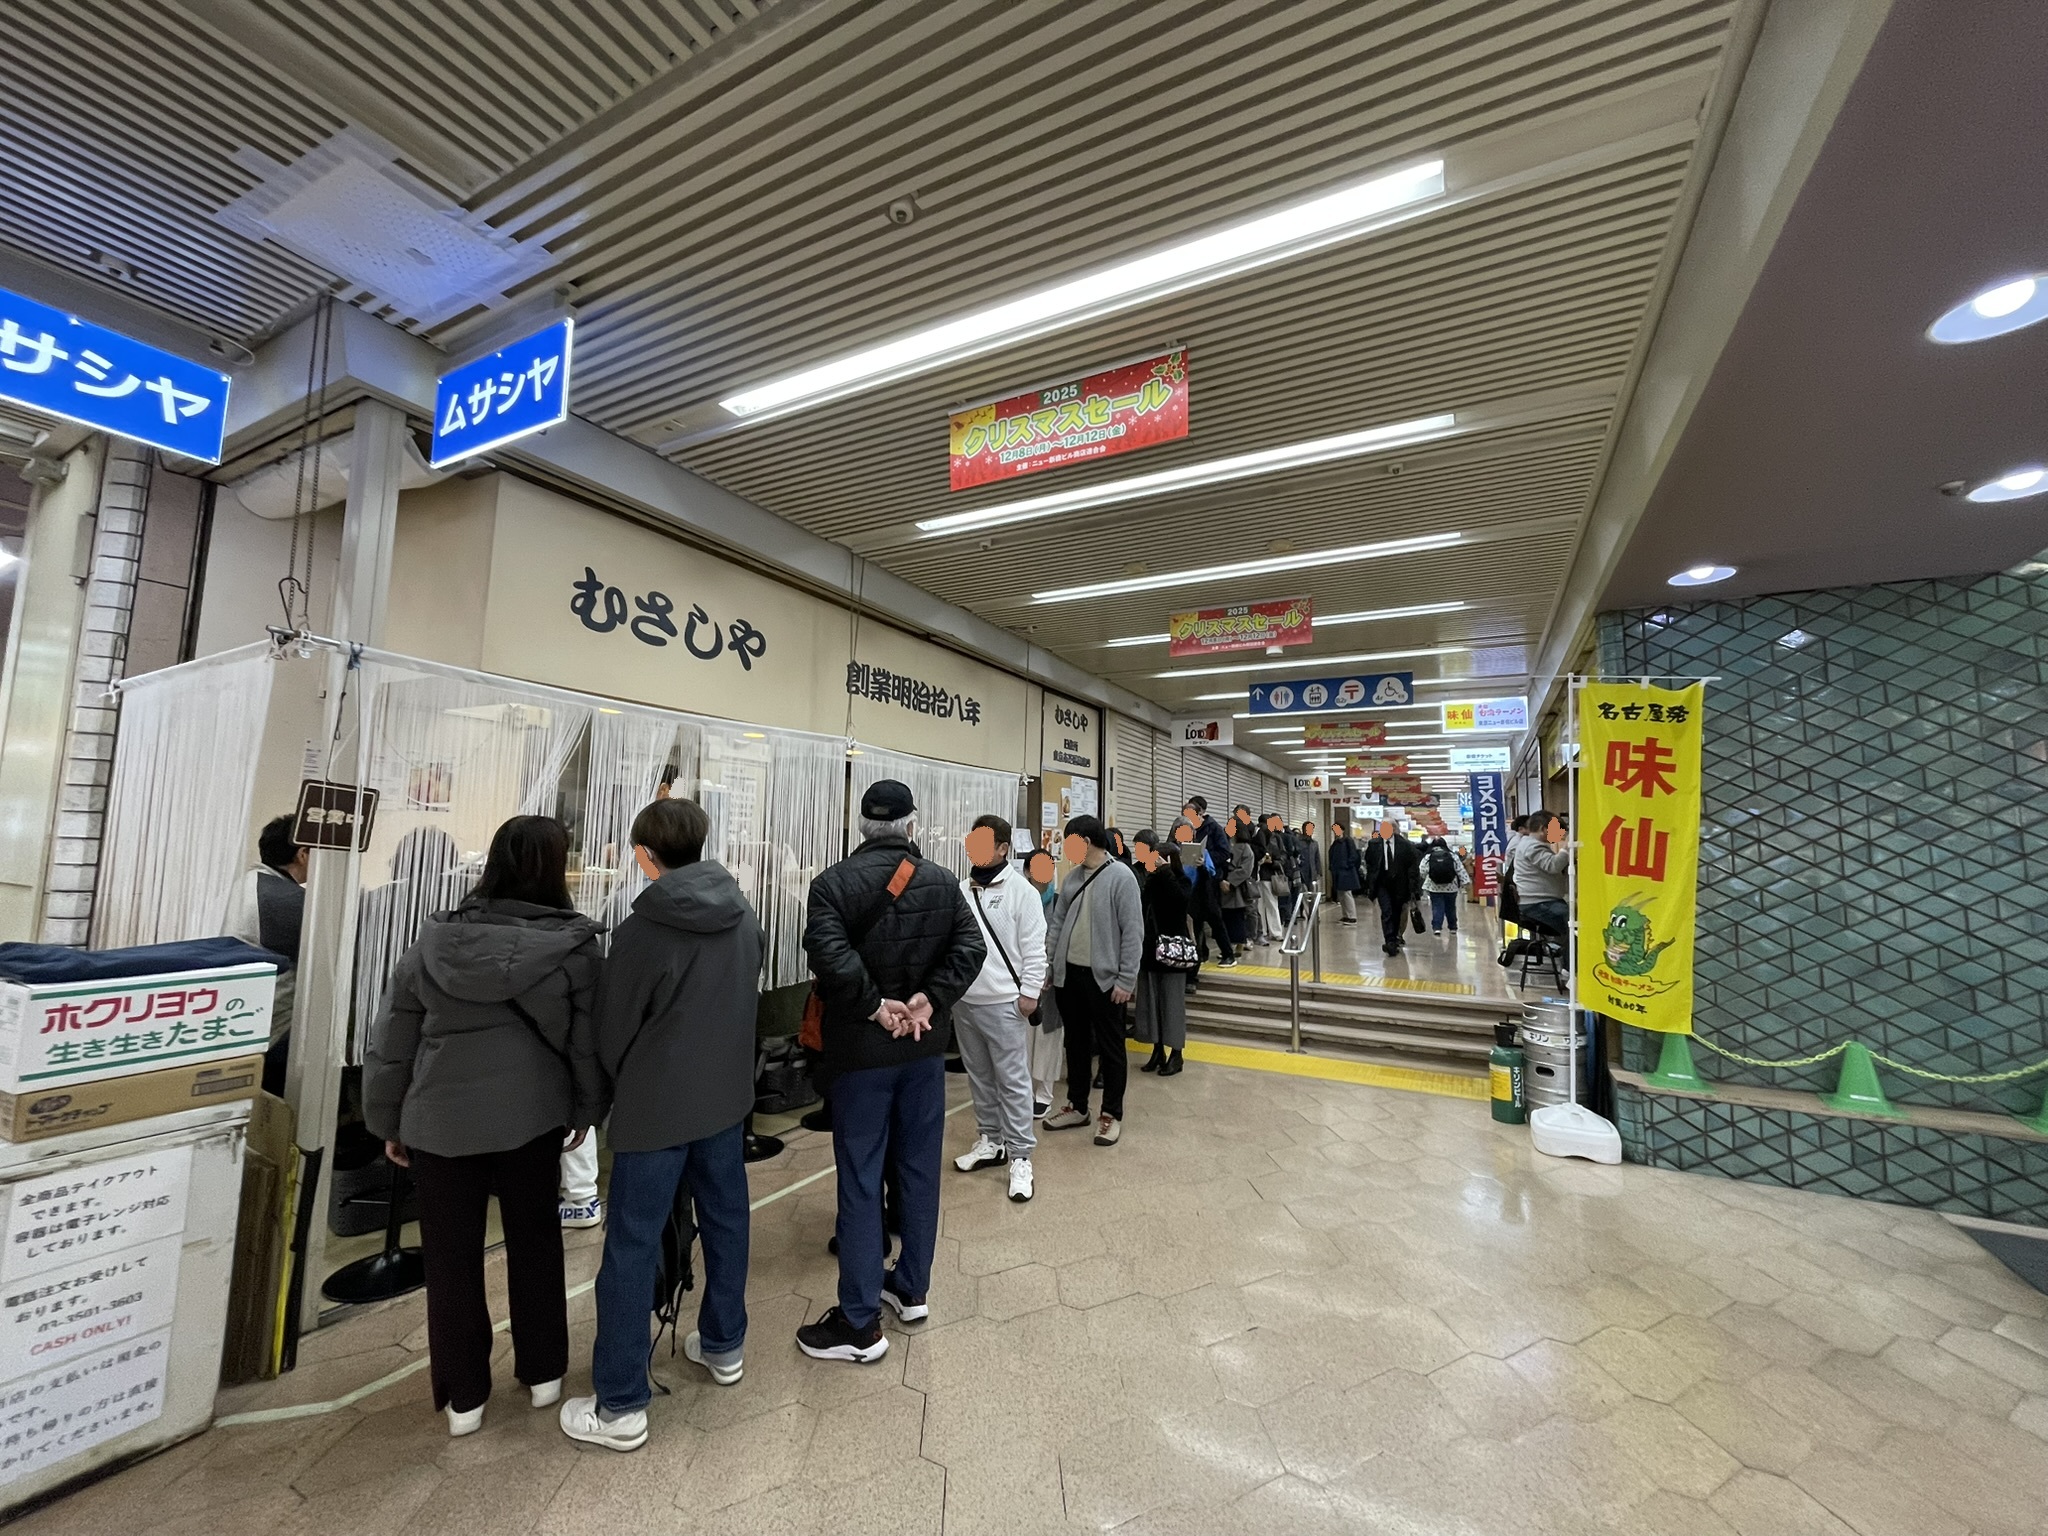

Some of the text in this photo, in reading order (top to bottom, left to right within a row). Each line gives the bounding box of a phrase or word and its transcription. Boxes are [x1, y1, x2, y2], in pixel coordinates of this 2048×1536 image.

[439, 354, 560, 438] ムサシヤ
[1043, 385, 1078, 405] 2025
[965, 379, 1173, 458] クリスマスセール
[570, 566, 767, 671] むさしや
[1179, 609, 1303, 640] クリスマスセール
[1227, 606, 1249, 615] 2025
[846, 660, 981, 727] 創業明治拾八年
[1598, 702, 1689, 723] 名古屋発
[1055, 704, 1089, 732] むさしや
[1447, 709, 1473, 721] 味仙
[1600, 737, 1678, 883] 味仙
[46, 1006, 264, 1066] 生き生きたまご
[1512, 1066, 1523, 1108] キリンビール
[18, 1165, 158, 1207] 全商品テイクアウト
[15, 1195, 170, 1244] 容器は電子レンジ対応
[31, 1197, 101, 1220] できます。
[30, 1315, 132, 1356] CASH ONLY!
